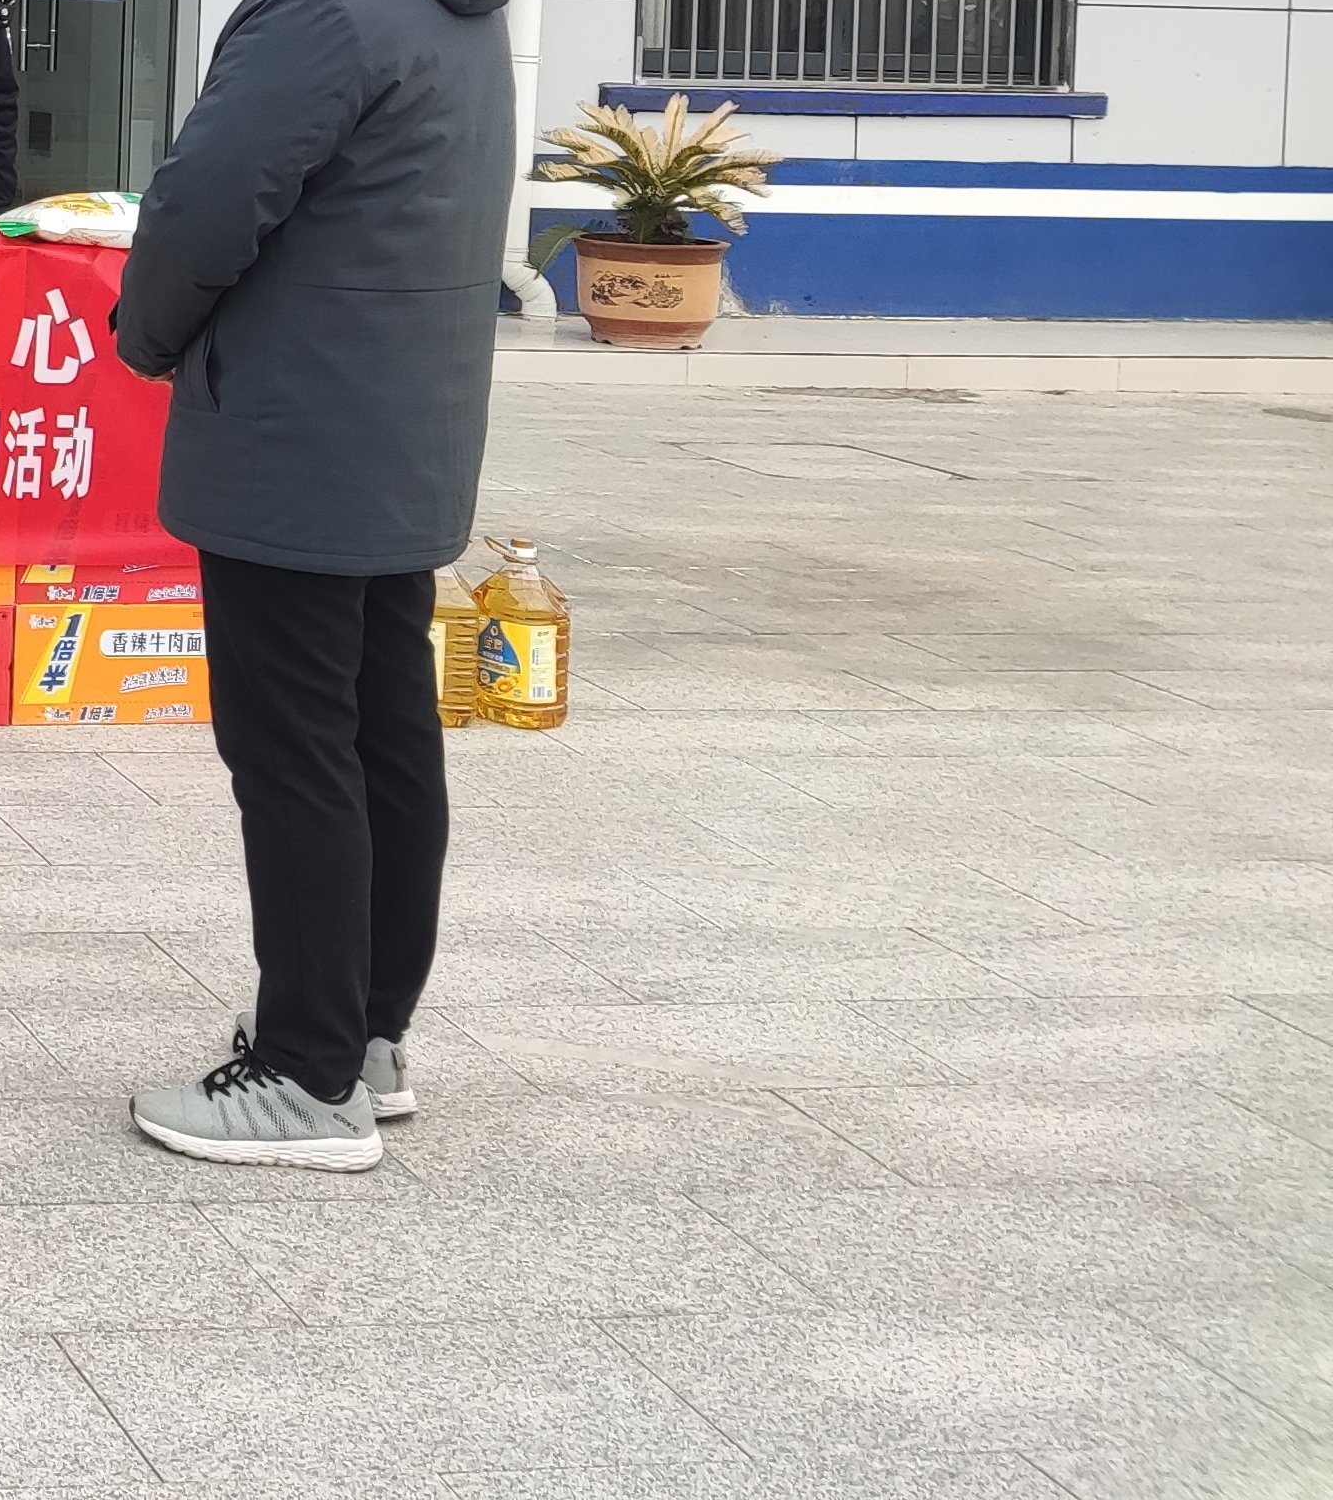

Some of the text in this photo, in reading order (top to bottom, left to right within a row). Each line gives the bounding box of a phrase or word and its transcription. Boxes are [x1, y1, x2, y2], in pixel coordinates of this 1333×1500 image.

[38, 613, 83, 692] 1倍半
[111, 632, 202, 654] 香辣牛肉面
